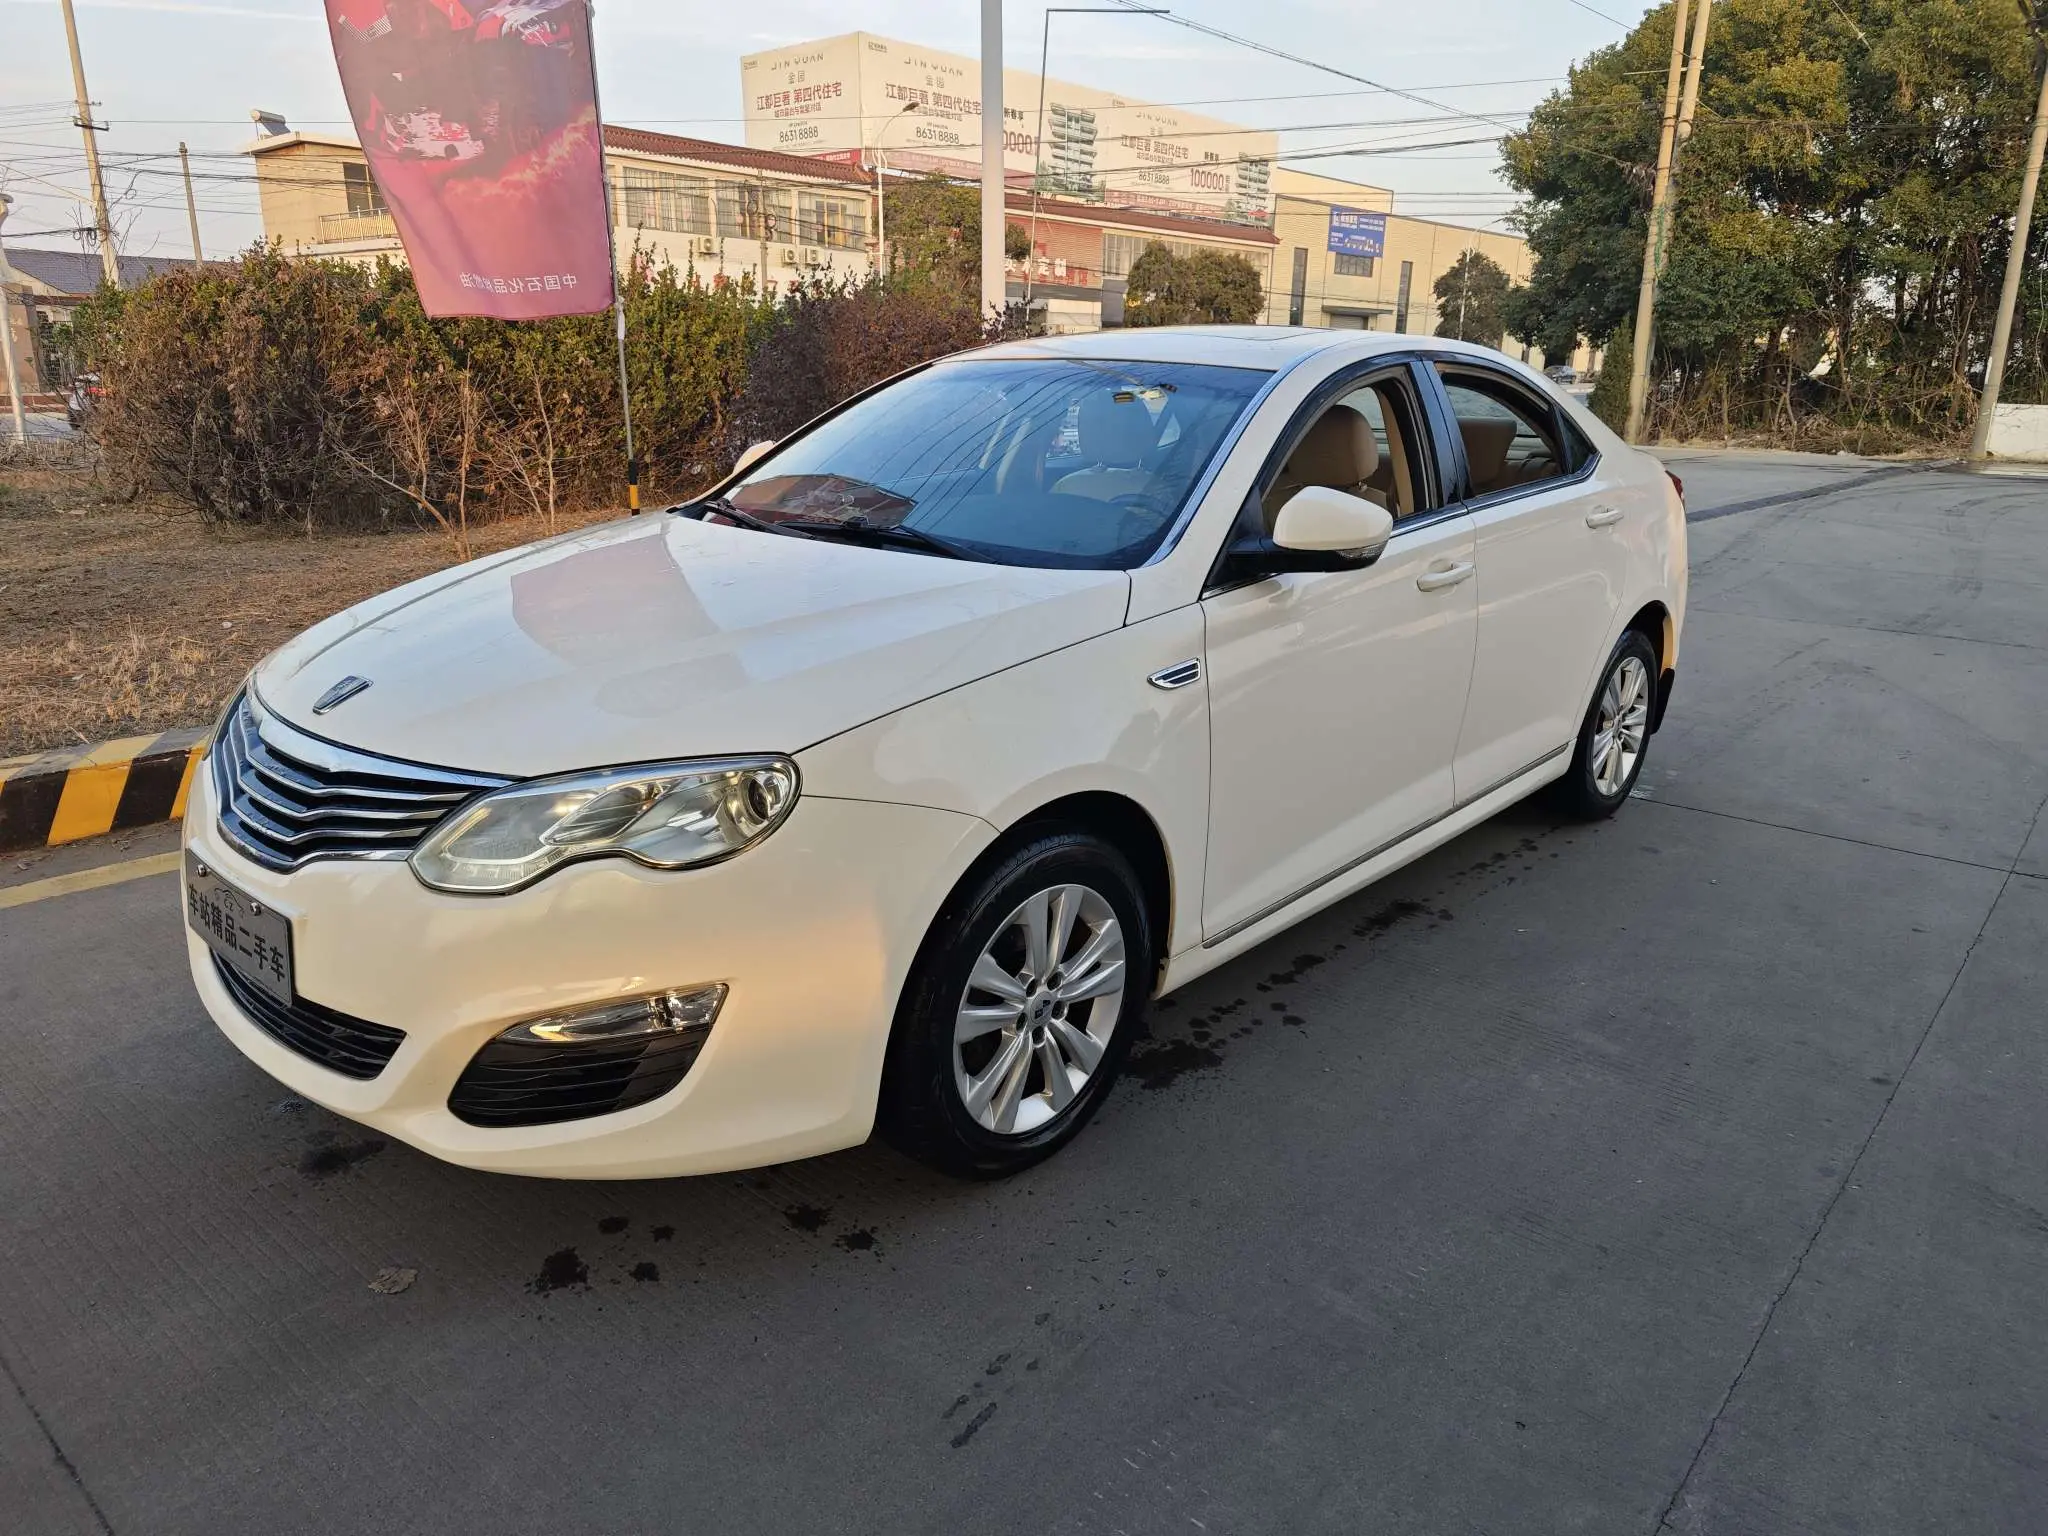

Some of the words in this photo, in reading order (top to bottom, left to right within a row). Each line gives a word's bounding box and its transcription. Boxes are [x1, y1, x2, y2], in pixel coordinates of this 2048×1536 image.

[904, 56, 928, 69] JIN
[757, 90, 791, 110] 江都巨著
[793, 82, 842, 104] 第四代住宅
[885, 82, 929, 105] 江都巨著
[932, 91, 982, 115] 第四代住宅
[779, 126, 819, 143] 86318888
[916, 126, 960, 144] 86318888
[1153, 140, 1189, 160] 第四代住宅
[1138, 172, 1170, 185] 86318888
[1190, 167, 1224, 191] 100000
[188, 883, 285, 983] 车站精品二手车
